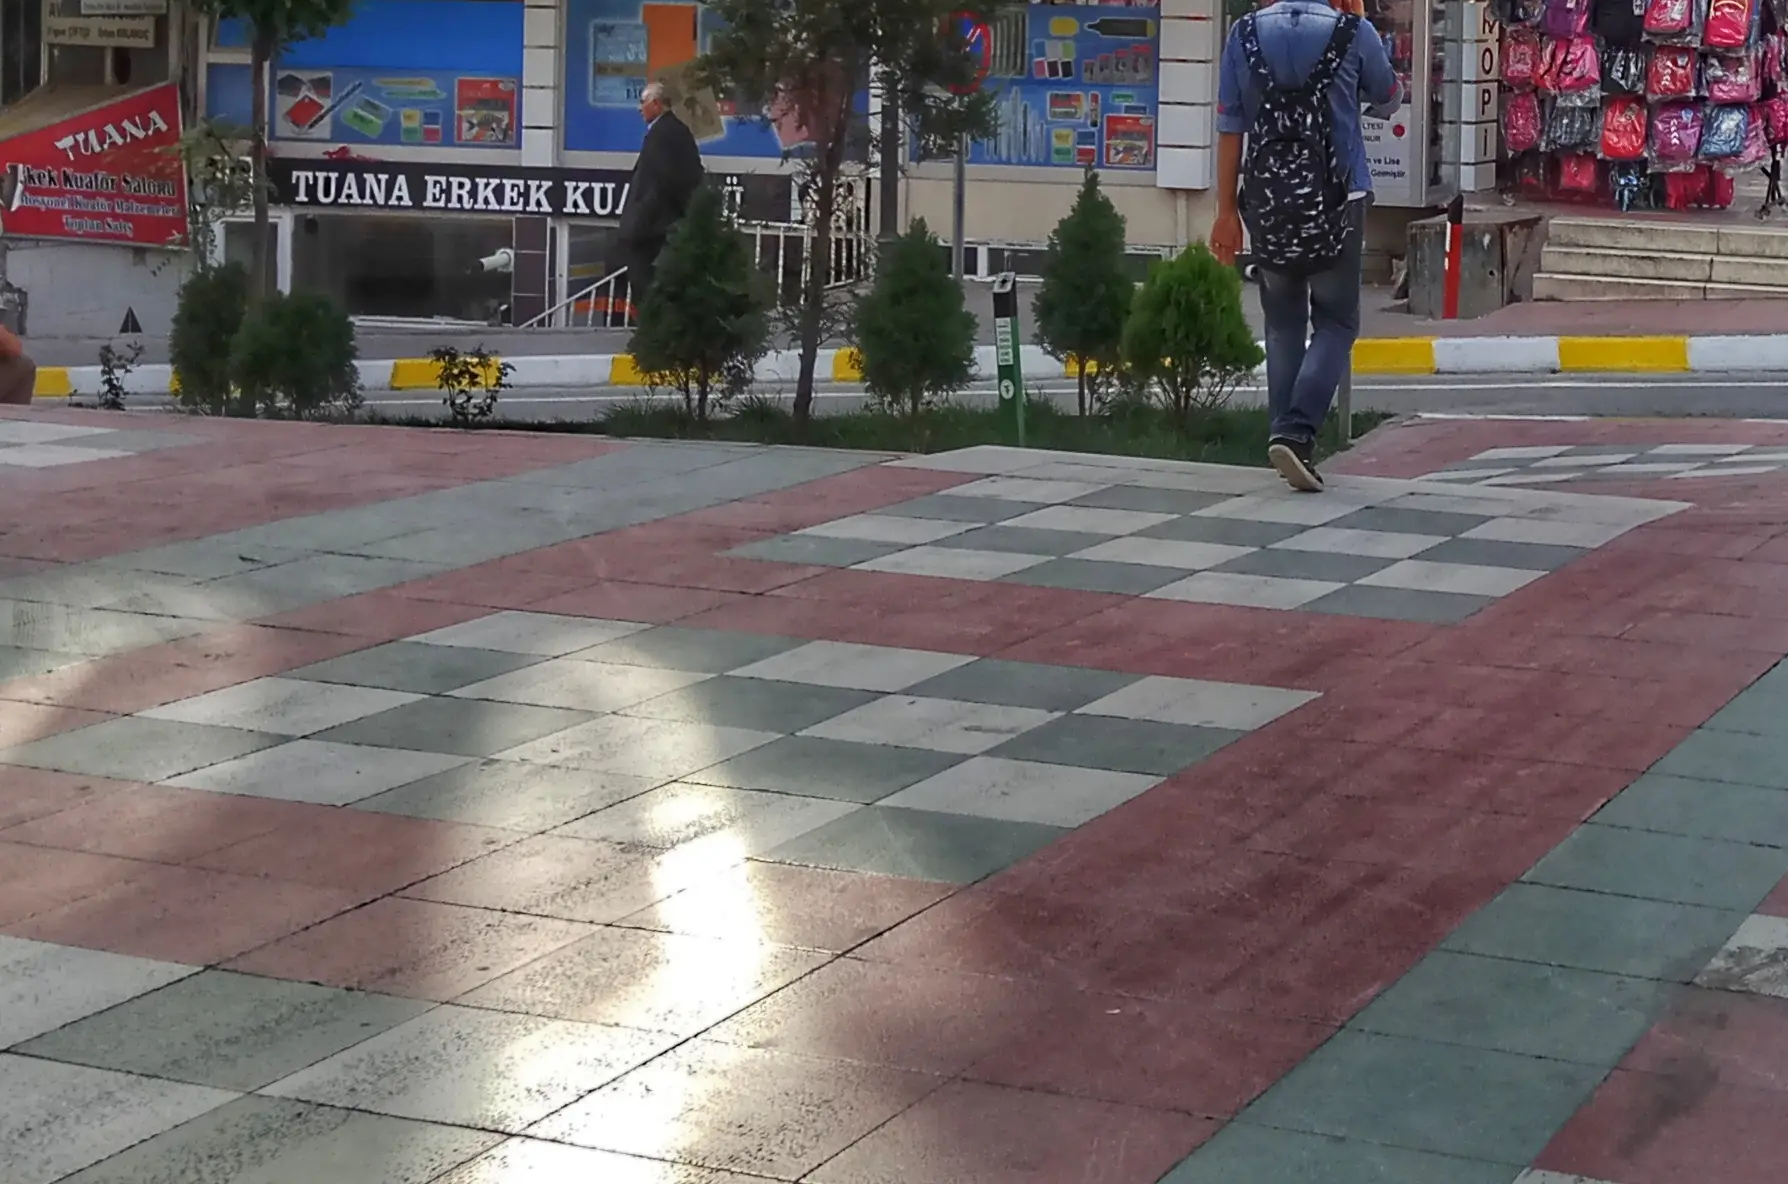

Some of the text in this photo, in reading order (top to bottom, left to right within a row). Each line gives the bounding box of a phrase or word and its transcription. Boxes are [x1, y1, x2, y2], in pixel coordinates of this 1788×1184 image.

[54, 110, 168, 161] TUANA
[292, 171, 413, 207] TUANA
[423, 175, 553, 213] ERKEK
